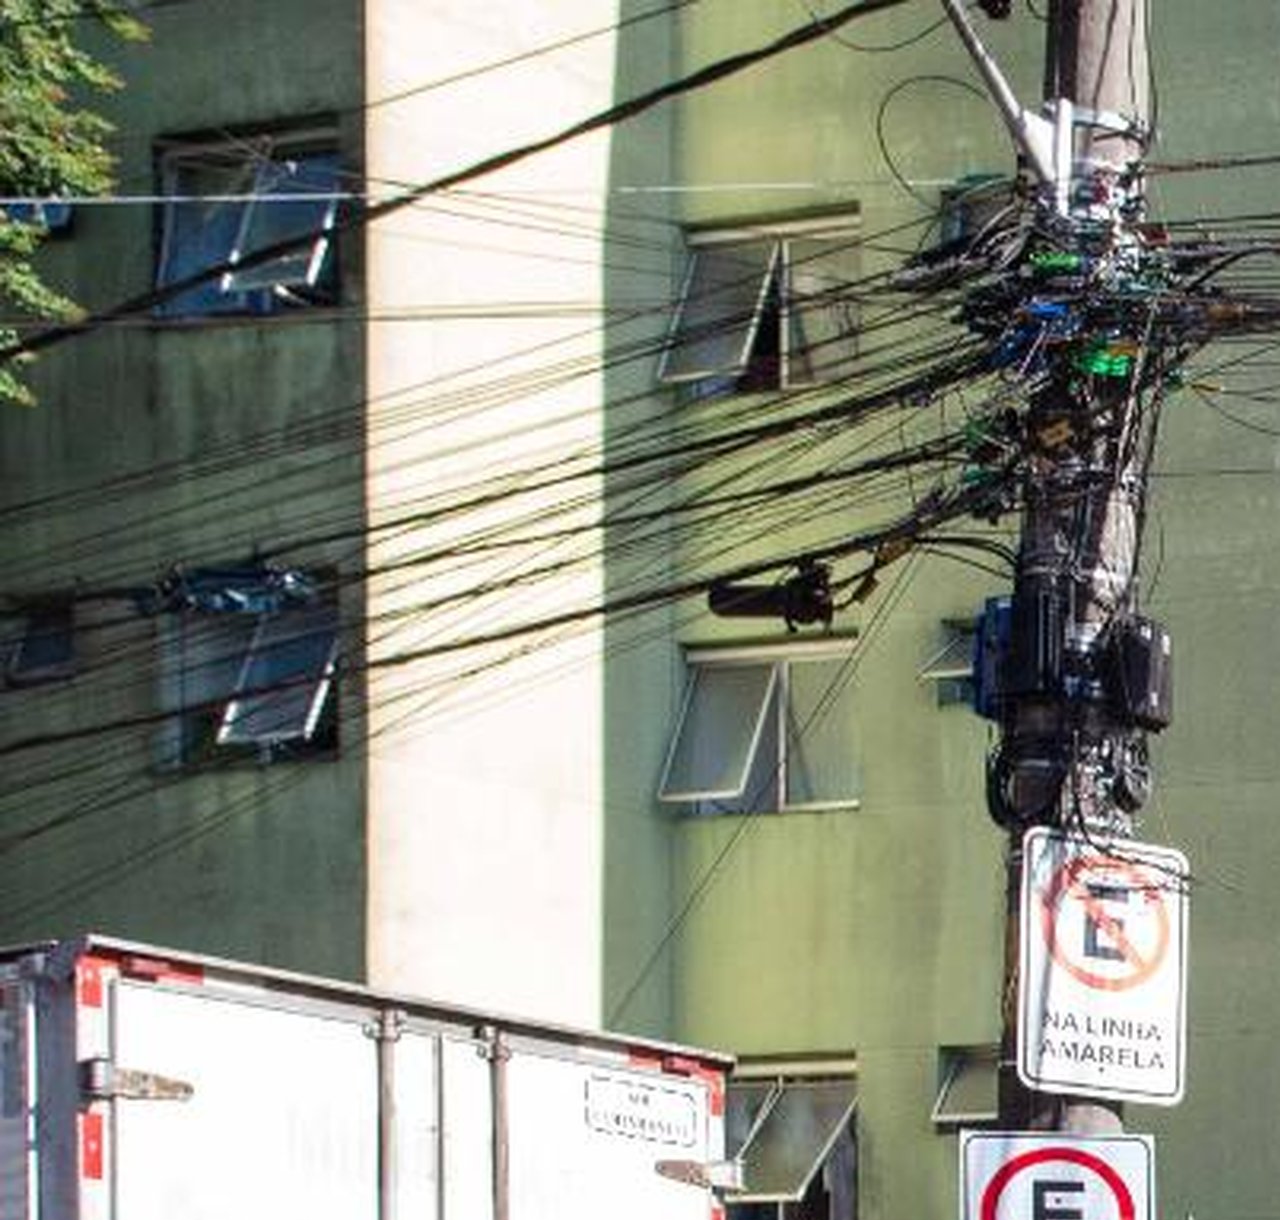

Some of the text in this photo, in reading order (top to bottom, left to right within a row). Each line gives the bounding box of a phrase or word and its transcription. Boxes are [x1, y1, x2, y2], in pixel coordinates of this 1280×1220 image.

[1083, 883, 1129, 963] E
[1043, 1010, 1162, 1042] NA LINHA
[1041, 1038, 1165, 1070] AMARELA
